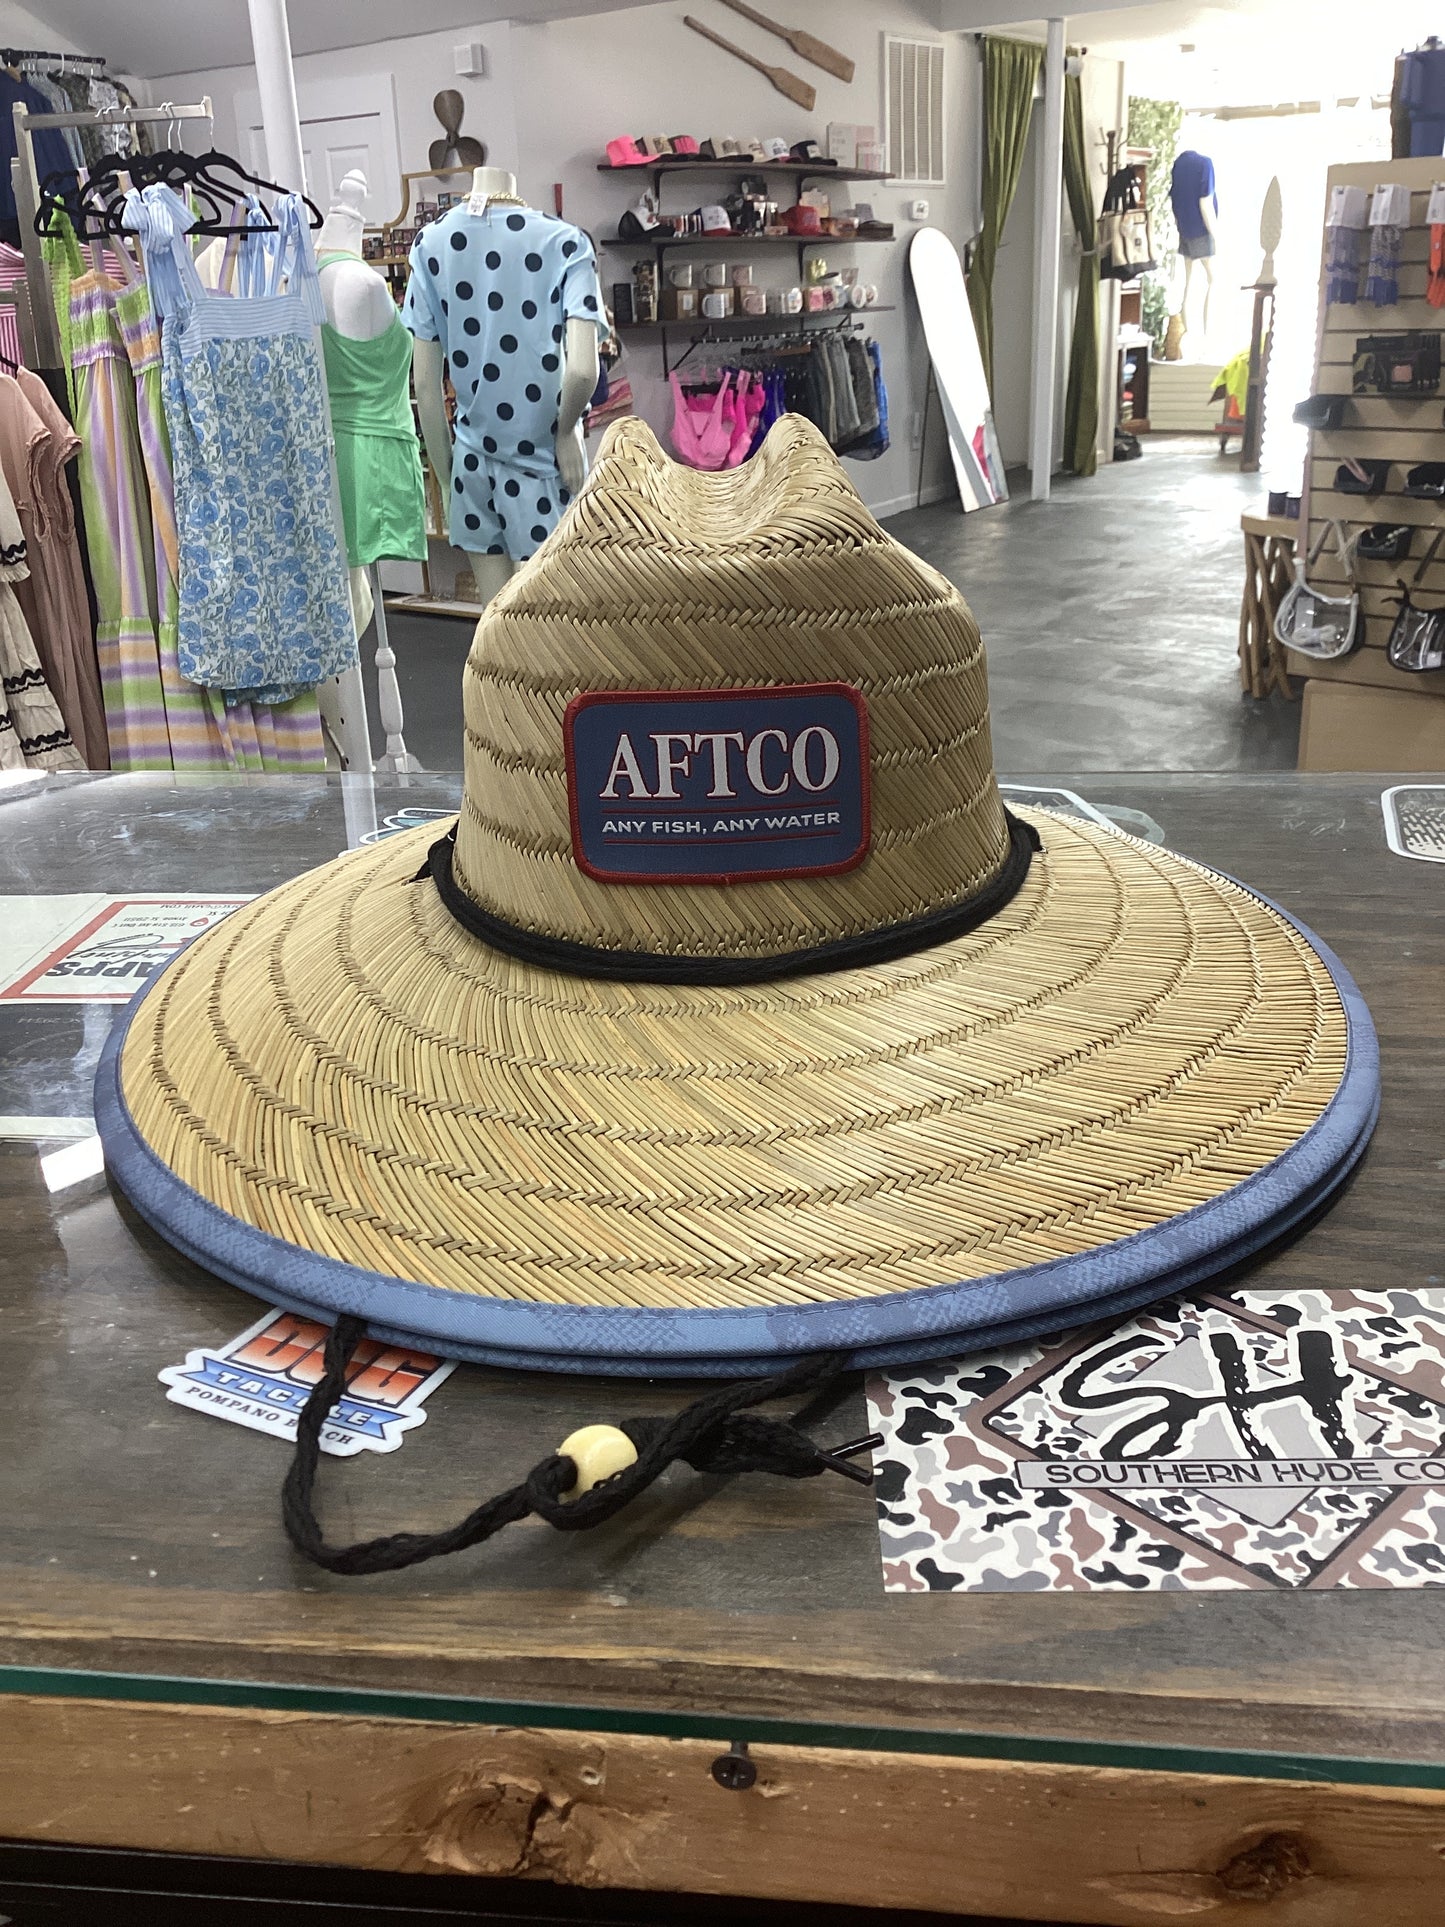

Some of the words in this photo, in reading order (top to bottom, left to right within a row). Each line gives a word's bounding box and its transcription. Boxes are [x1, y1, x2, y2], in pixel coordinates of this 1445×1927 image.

[599, 727, 840, 798] AFTCO
[602, 820, 646, 833] ANY
[652, 820, 708, 834] FISH,
[713, 818, 760, 833] ANY
[764, 811, 841, 829] WATER
[184, 1386, 280, 1422] POMPANO
[284, 1418, 354, 1445] BCH
[217, 1371, 373, 1427] TACLE
[1045, 1463, 1263, 1484] SOUTHERN
[1271, 1462, 1384, 1482] HYDE
[1393, 1461, 1445, 1481] CO
